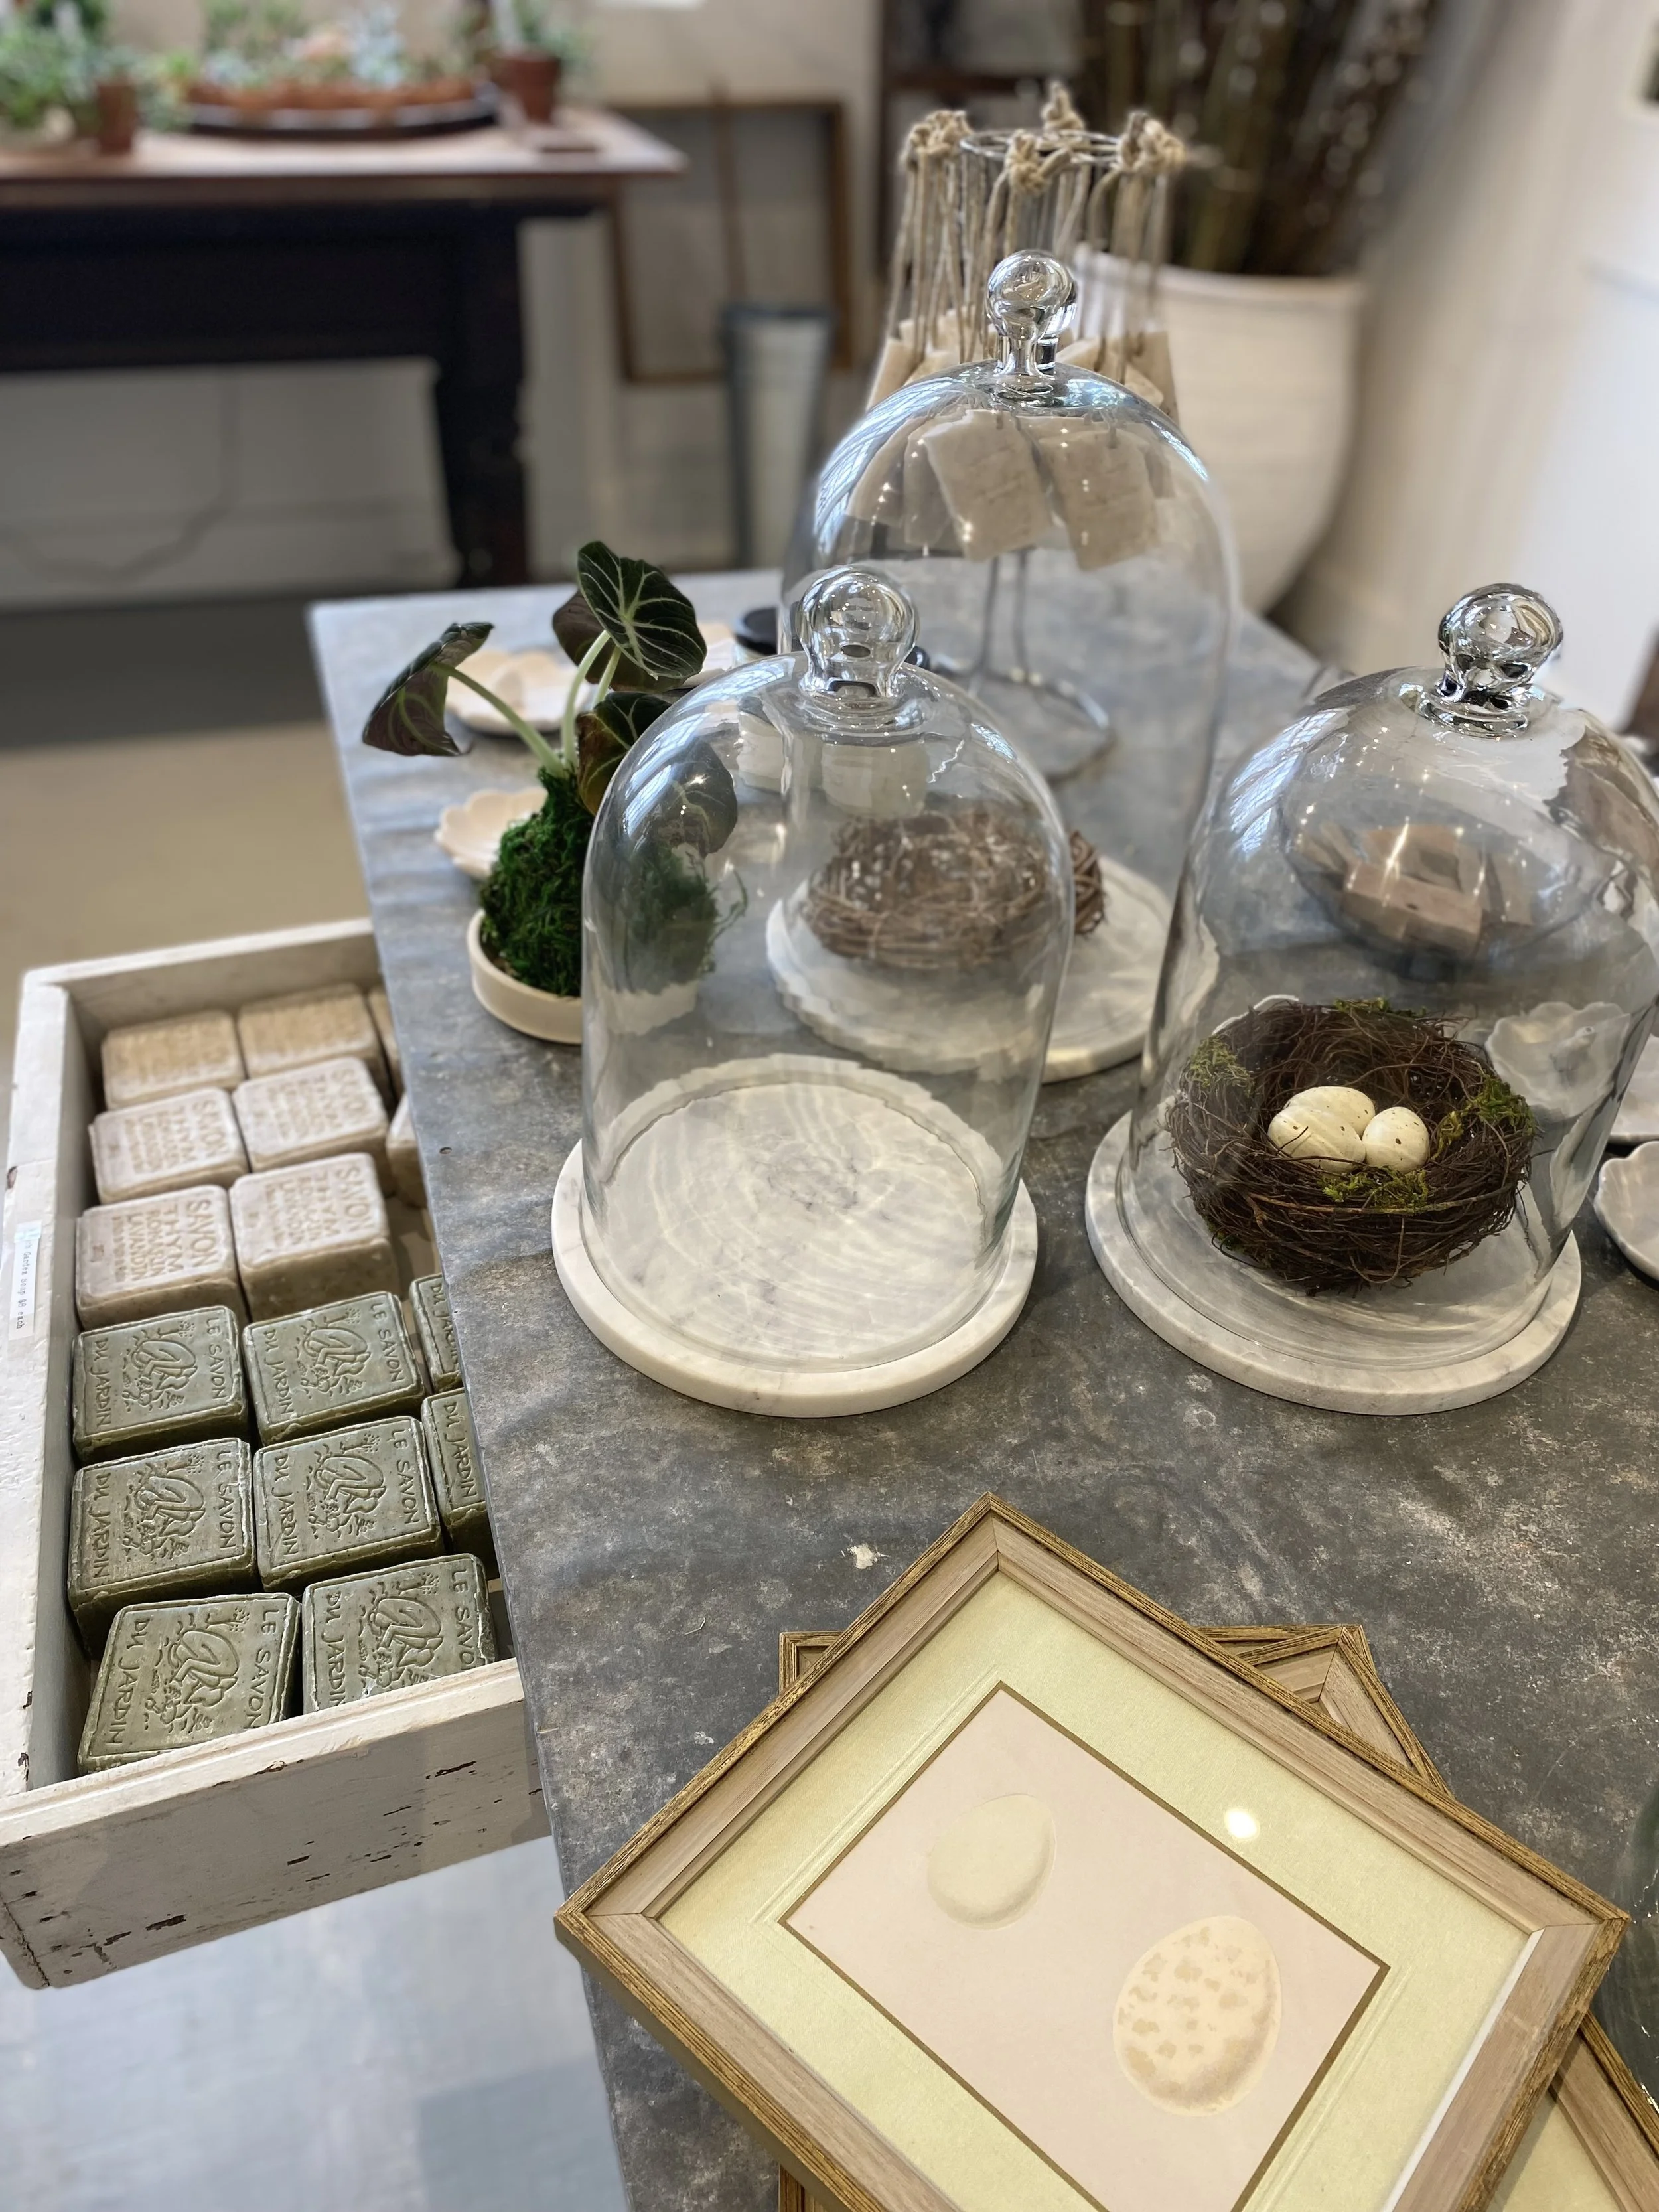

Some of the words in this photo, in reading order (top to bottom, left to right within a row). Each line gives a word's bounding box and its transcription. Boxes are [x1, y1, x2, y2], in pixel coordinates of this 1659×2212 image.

[313, 1169, 342, 1236] THYM
[334, 1166, 376, 1232] SAVON
[127, 1212, 148, 1282] LAVANDIN
[163, 1203, 184, 1272] THYM
[186, 1199, 219, 1268] SAVON
[21, 1251, 32, 1275] Garden
[18, 1299, 27, 1308] $8
[370, 1301, 387, 1321] LE
[431, 1282, 447, 1306] DU
[16, 1311, 26, 1329] each
[205, 1317, 222, 1337] LE
[263, 1327, 279, 1353] DU
[94, 1337, 109, 1361] DU
[378, 1329, 405, 1382] SAVON
[208, 1343, 228, 1401] SAVON
[265, 1358, 295, 1416] JARDIN
[90, 1366, 112, 1428] JARDIN
[443, 1400, 461, 1429] DU
[216, 1449, 232, 1472] LE
[390, 1429, 409, 1450] LE
[94, 1472, 111, 1501] DU
[274, 1453, 290, 1482] DU
[443, 1432, 478, 1499] JARDIN
[396, 1459, 420, 1525] SAVON
[218, 1482, 237, 1551] SAVON
[271, 1487, 299, 1556] JARDIN
[89, 1505, 111, 1579] JARDIN
[451, 1568, 469, 1593] LE
[260, 1609, 280, 1635] LE
[325, 1590, 342, 1625] DU
[126, 1617, 151, 1651] DU
[455, 1606, 477, 1670] SAVO
[105, 1657, 141, 1746] JARDIN
[242, 1647, 272, 1730] SAVON
